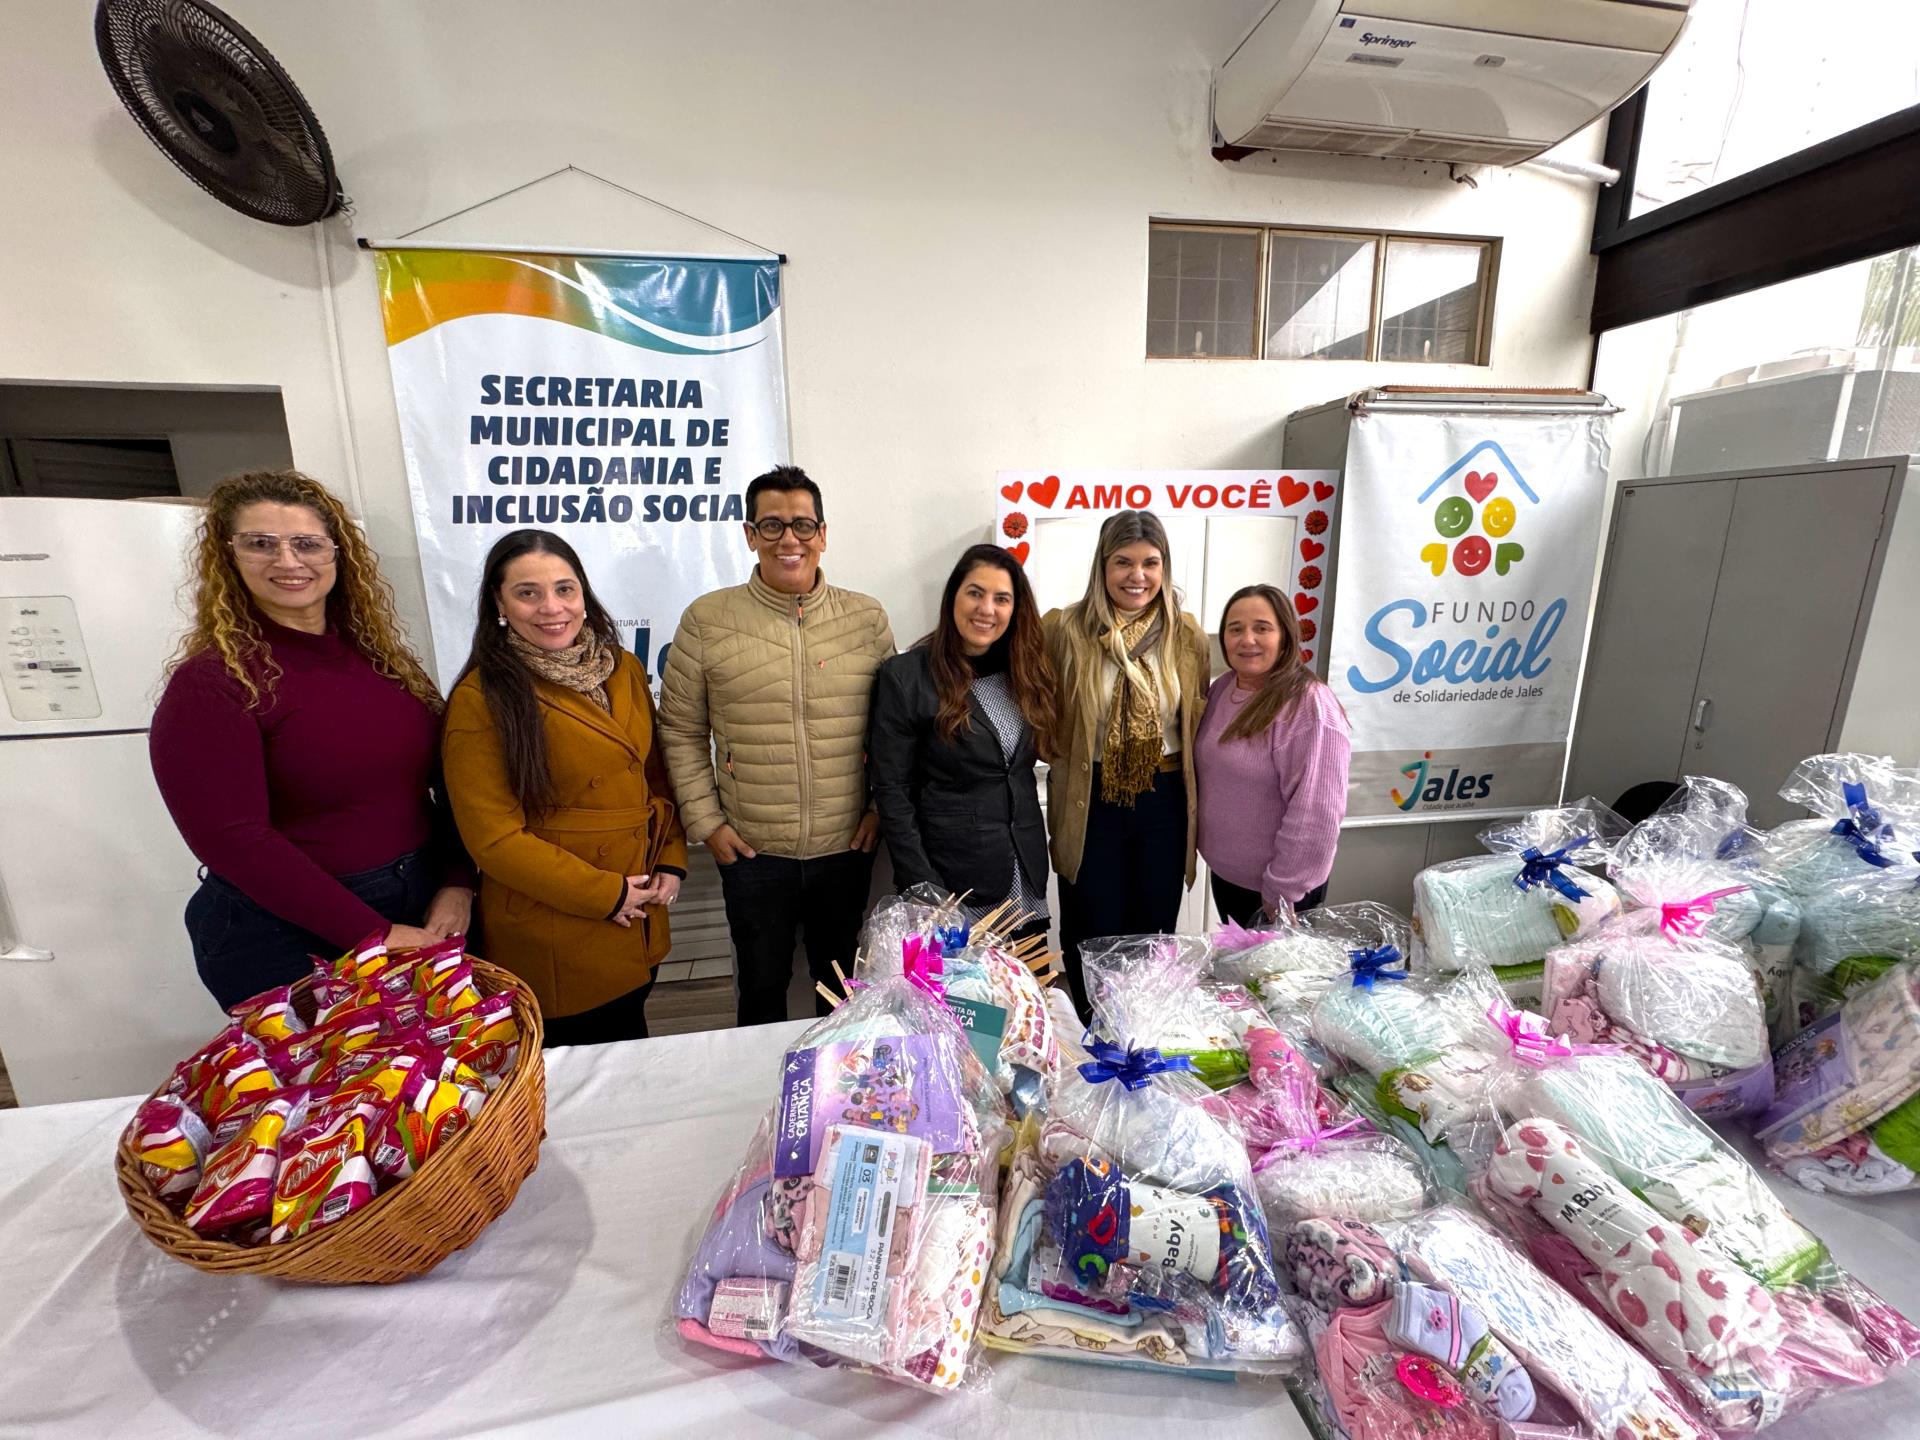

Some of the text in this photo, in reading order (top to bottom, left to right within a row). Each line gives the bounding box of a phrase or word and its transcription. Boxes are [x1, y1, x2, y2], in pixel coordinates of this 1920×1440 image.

[1359, 32, 1416, 49] Springer
[480, 374, 703, 409] SECRETARIA
[470, 415, 730, 447] MUNICIPAL DE
[487, 455, 722, 486] CIDADANIA E
[452, 487, 743, 525] INCLUSÃO SOCIA
[1065, 479, 1272, 510] AMO VOCÊ
[610, 619, 639, 628] EITURA
[1431, 599, 1535, 624] FUNDO
[1347, 597, 1567, 694] Social
[1393, 685, 1543, 704] de Solidariedade de Jales
[1390, 751, 1494, 812] Jales
[966, 1008, 977, 1017] DA
[788, 1080, 799, 1139] CADERNETA DA
[796, 1077, 813, 1137] CRIANÇA
[862, 1169, 871, 1183] 03
[1161, 1219, 1185, 1268] Baby
[873, 1242, 885, 1281] PANINHO
[870, 1281, 878, 1294] DE
[865, 1294, 876, 1319] BOCA
